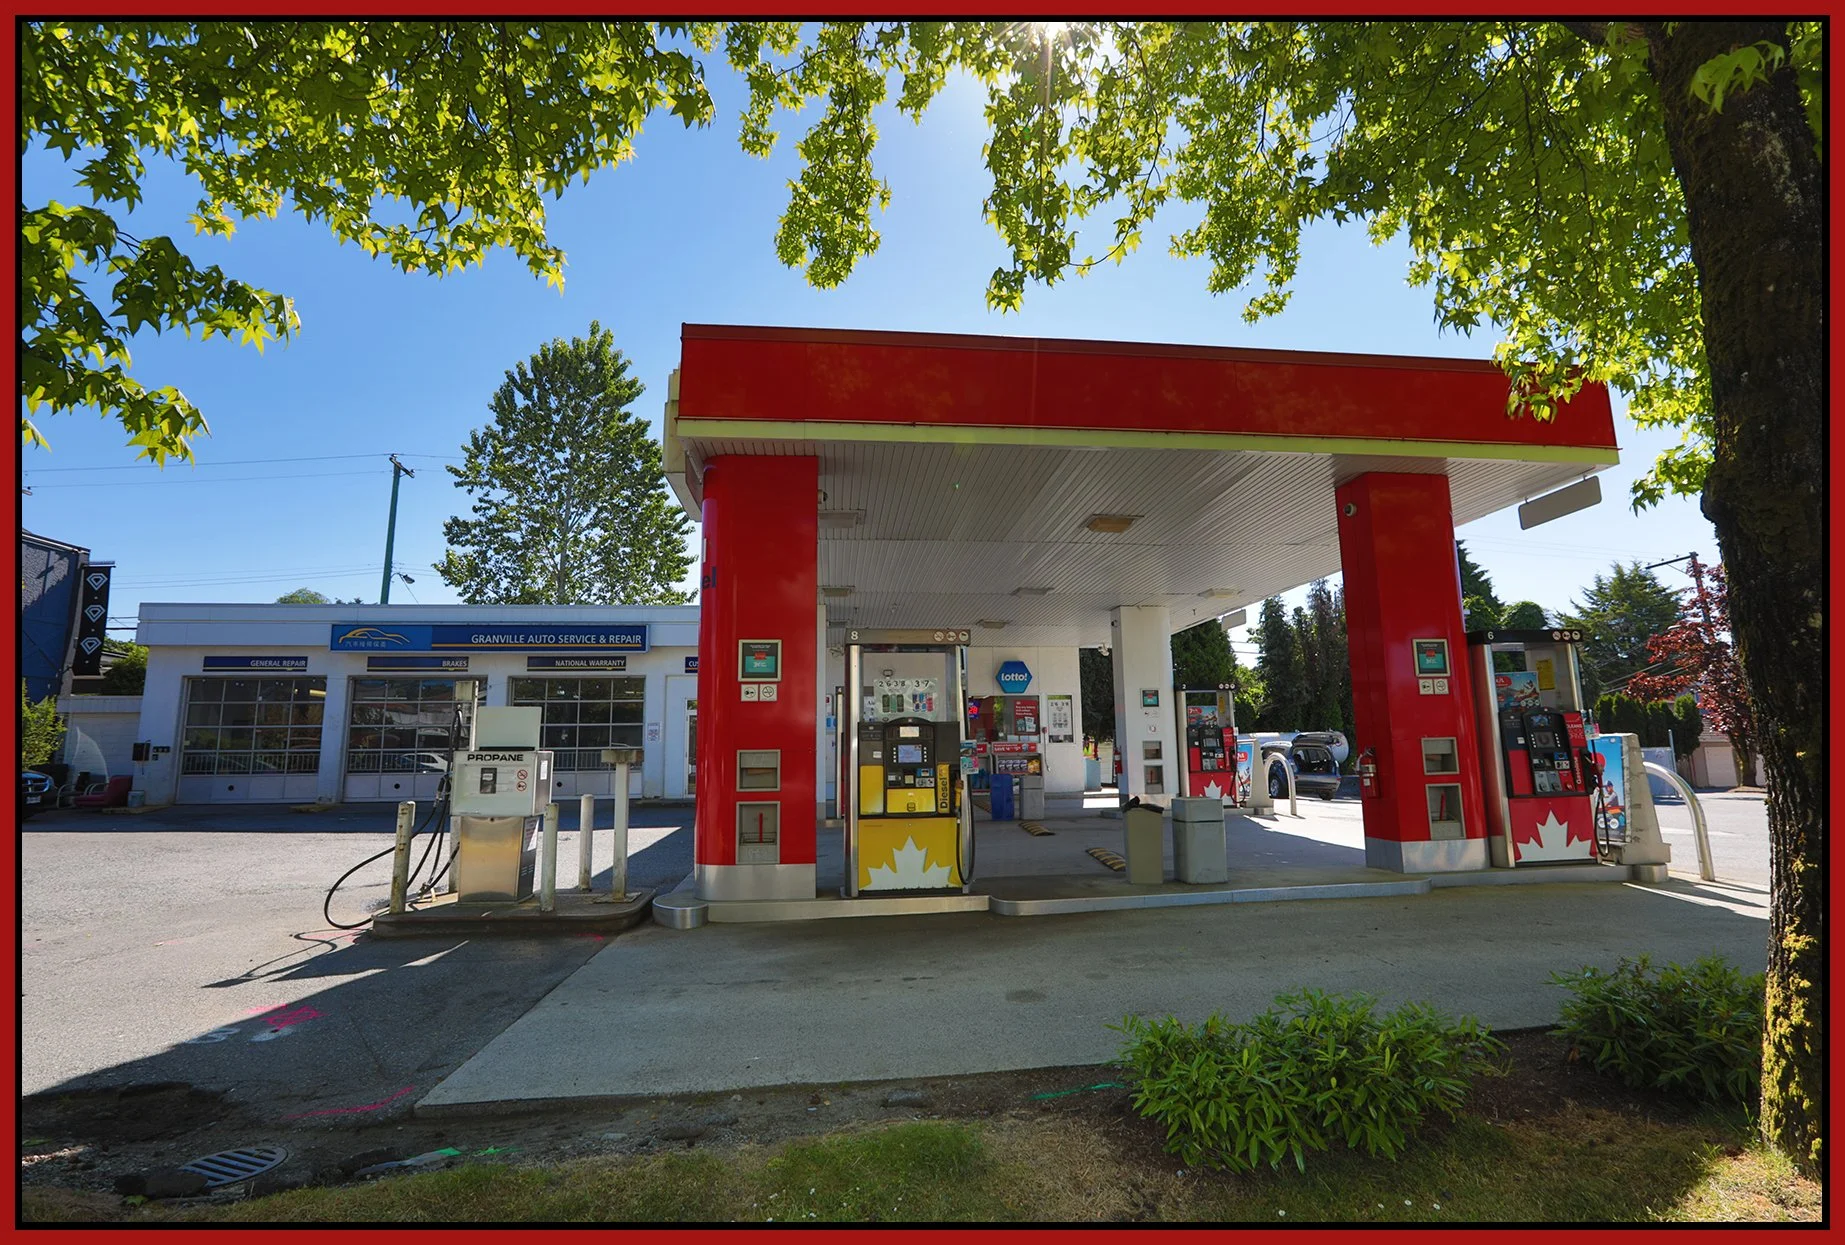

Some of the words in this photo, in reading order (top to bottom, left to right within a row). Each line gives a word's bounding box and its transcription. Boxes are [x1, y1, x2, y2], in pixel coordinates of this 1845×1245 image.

[471, 634, 525, 644] GRANVILLE
[527, 634, 556, 644] AUTO
[558, 634, 596, 644] SERVICE
[599, 634, 607, 644] &
[609, 634, 642, 644] REPAIR
[851, 630, 858, 640] 8
[1488, 632, 1494, 640] 6
[1001, 672, 1028, 682] lotto!
[467, 754, 524, 762] PROPANE
[940, 776, 948, 808] Diesel
